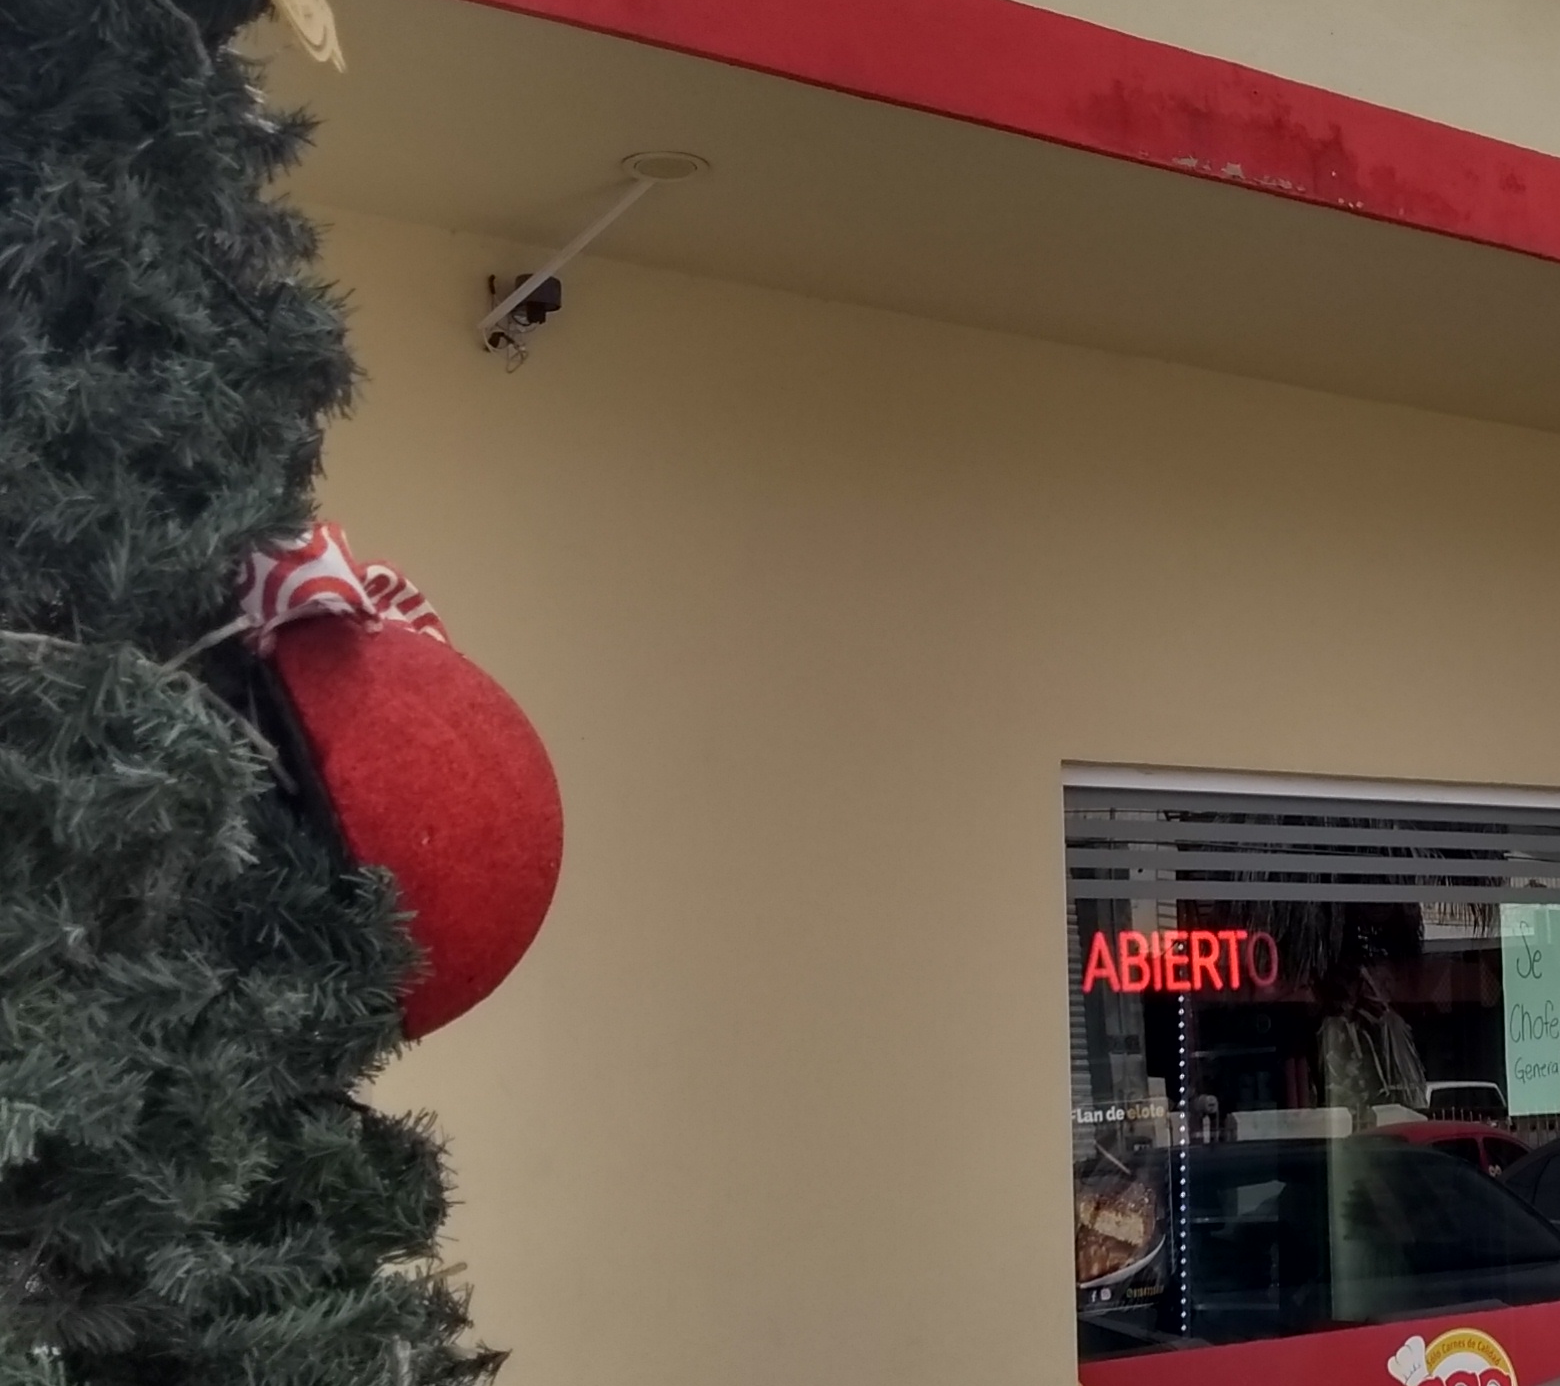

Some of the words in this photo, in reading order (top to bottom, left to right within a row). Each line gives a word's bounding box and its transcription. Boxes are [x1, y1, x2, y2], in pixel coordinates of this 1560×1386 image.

[1082, 929, 1278, 993] ABIERTO
[1516, 921, 1543, 980] Se
[1106, 1106, 1125, 1121] de
[1127, 1103, 1165, 1120] elote
